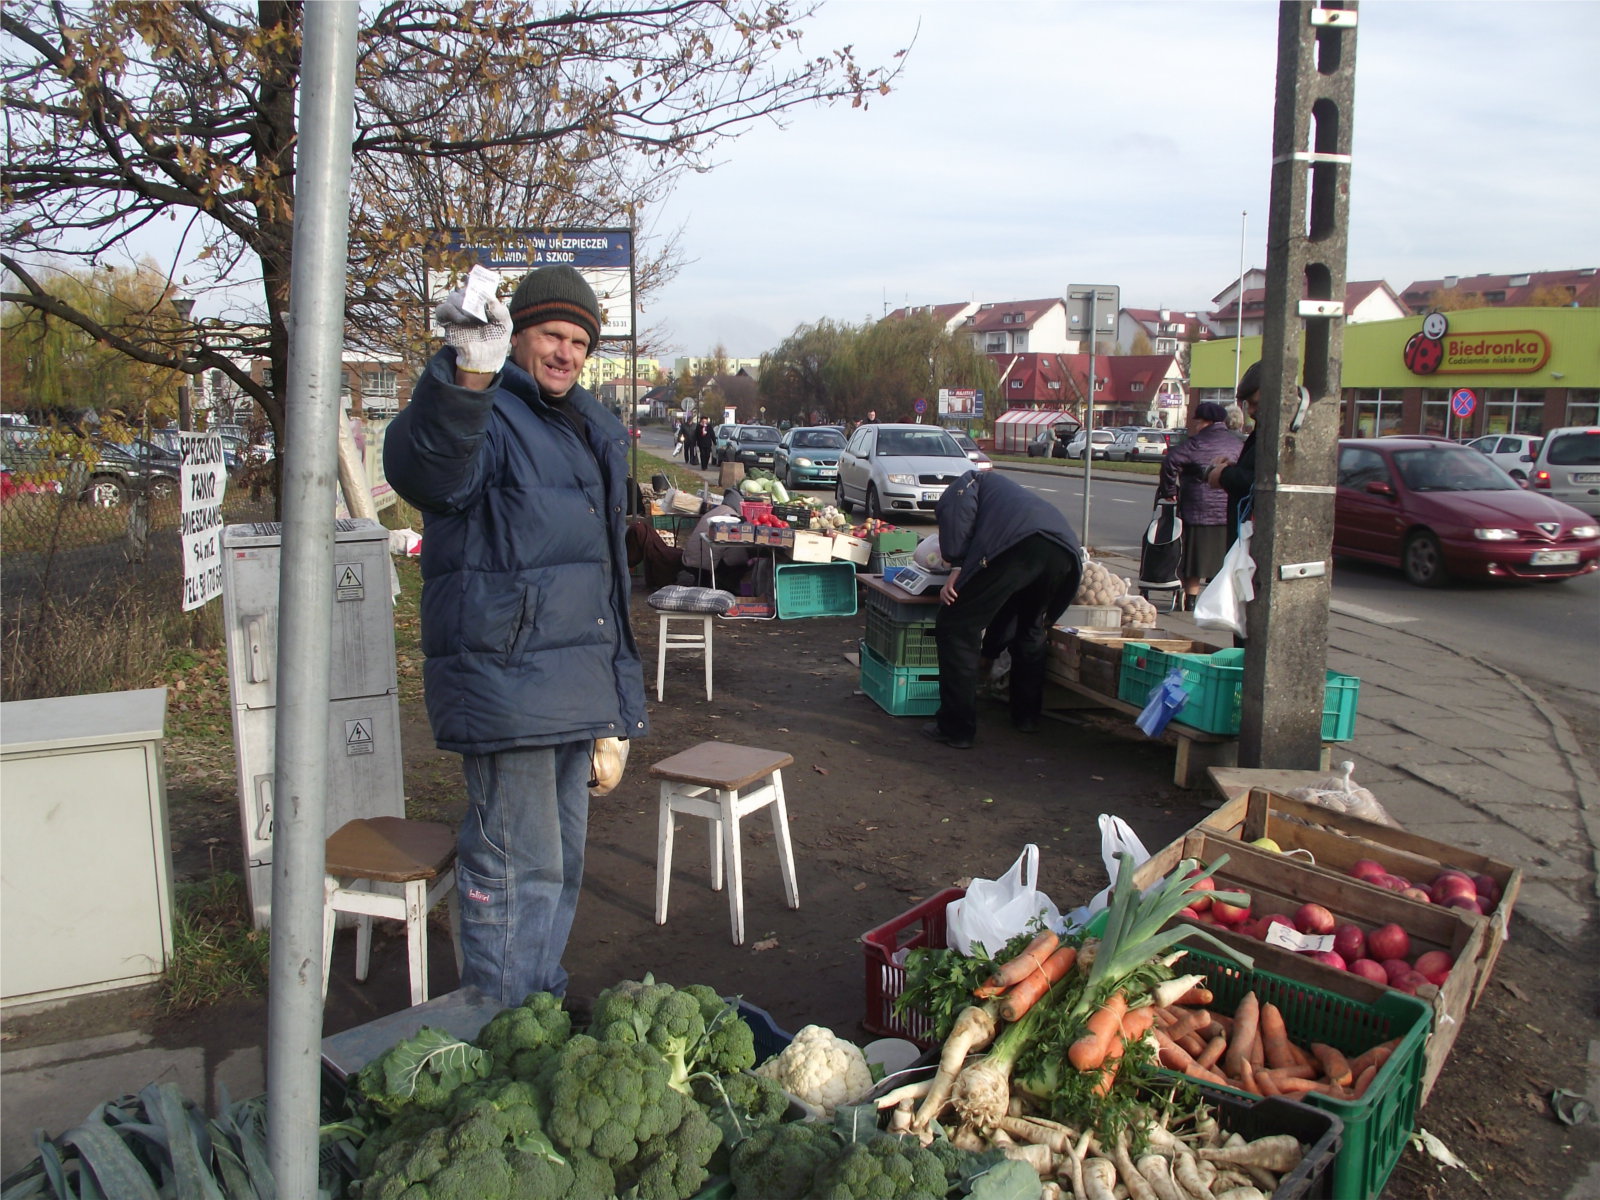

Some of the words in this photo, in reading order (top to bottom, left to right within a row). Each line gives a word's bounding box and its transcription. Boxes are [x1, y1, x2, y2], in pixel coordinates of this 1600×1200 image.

[1448, 356, 1490, 365] Codziennie
[1492, 355, 1515, 364] niskie
[1518, 356, 1537, 365] ceny
[1449, 338, 1538, 356] Biedronka
[181, 437, 223, 466] SPRZEDAM
[191, 471, 216, 502] TANIO
[182, 504, 223, 536] MIESZKANIE
